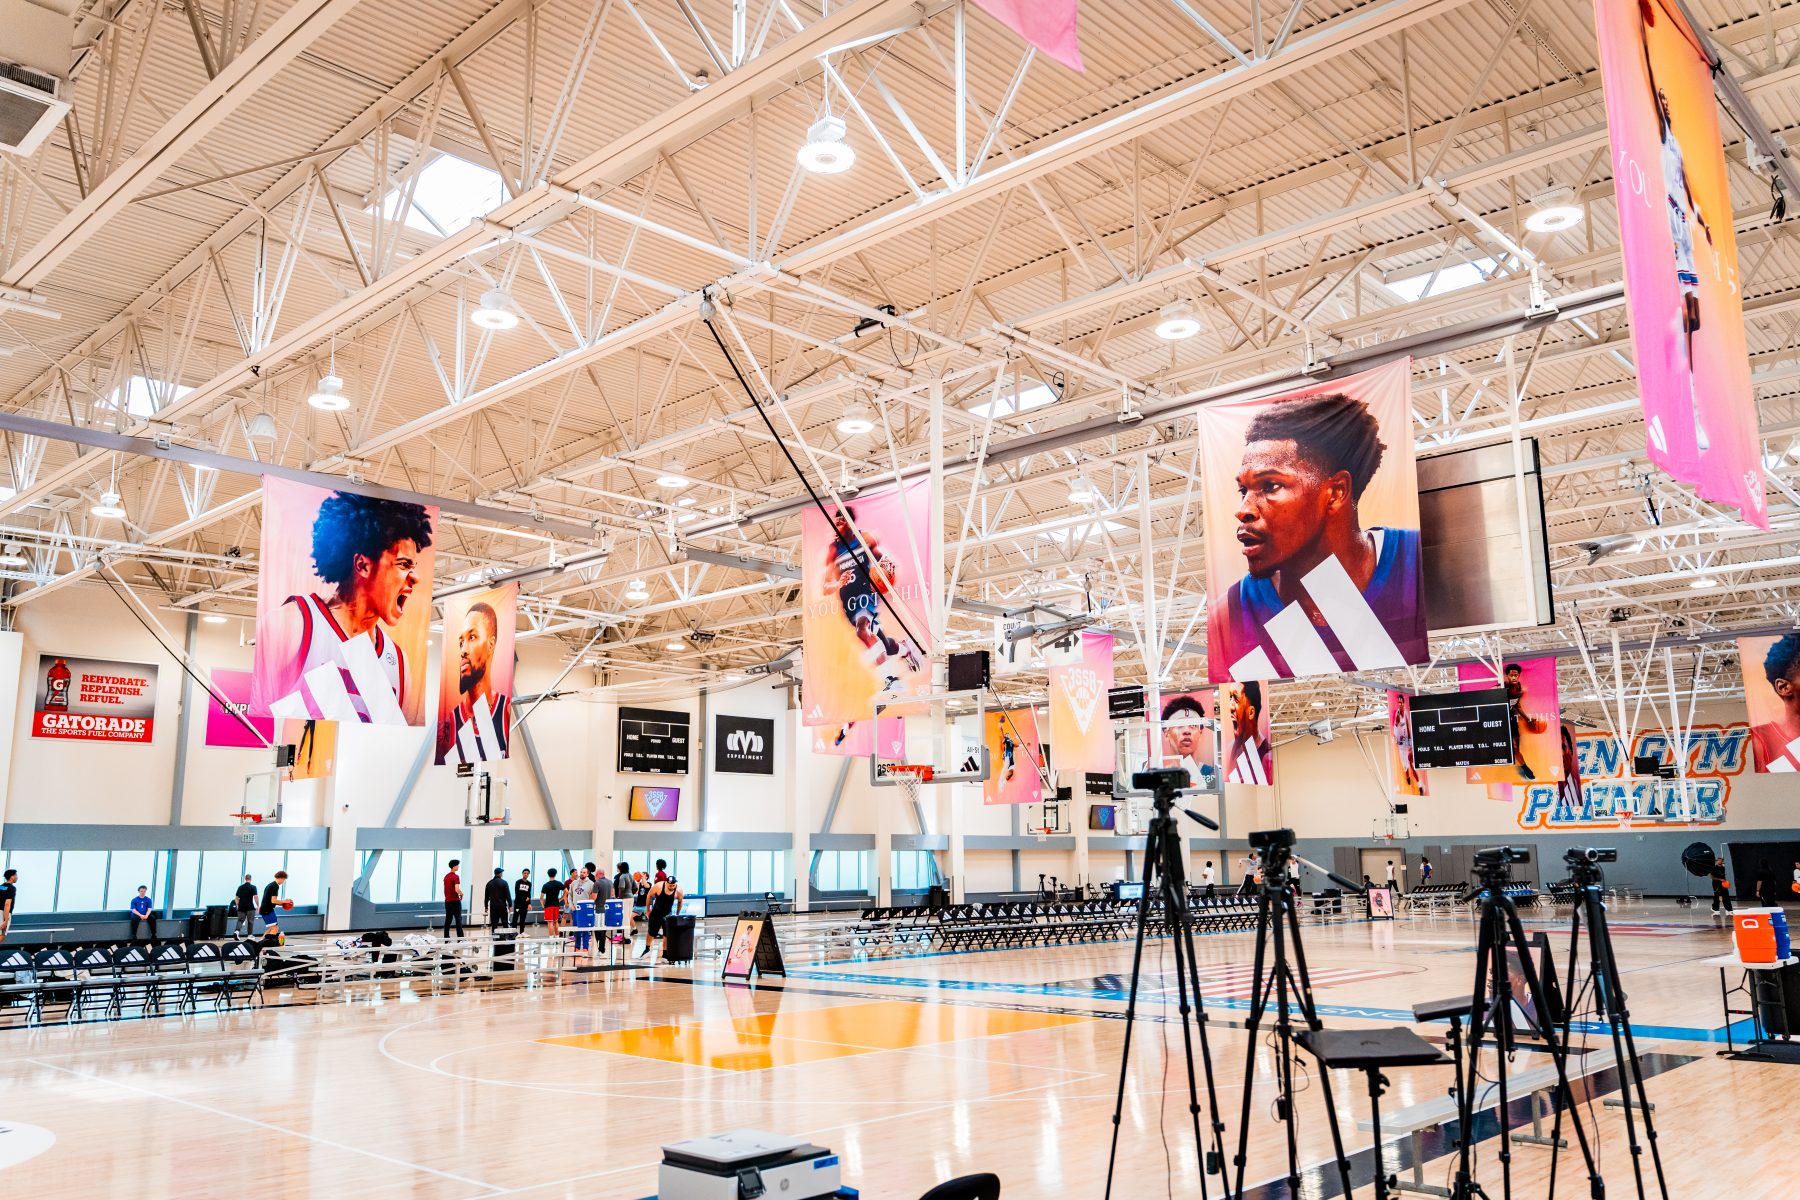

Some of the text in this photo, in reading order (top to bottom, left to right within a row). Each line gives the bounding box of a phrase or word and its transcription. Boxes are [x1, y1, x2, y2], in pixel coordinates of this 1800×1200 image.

[809, 600, 839, 619] YOU
[847, 592, 878, 611] GOT
[82, 674, 149, 687] REHYDRATE.
[81, 684, 143, 696] REPLENISH.
[80, 694, 125, 704] REFUEL.
[42, 713, 145, 733] GATORADE
[1418, 720, 1502, 733] HOME GUEST
